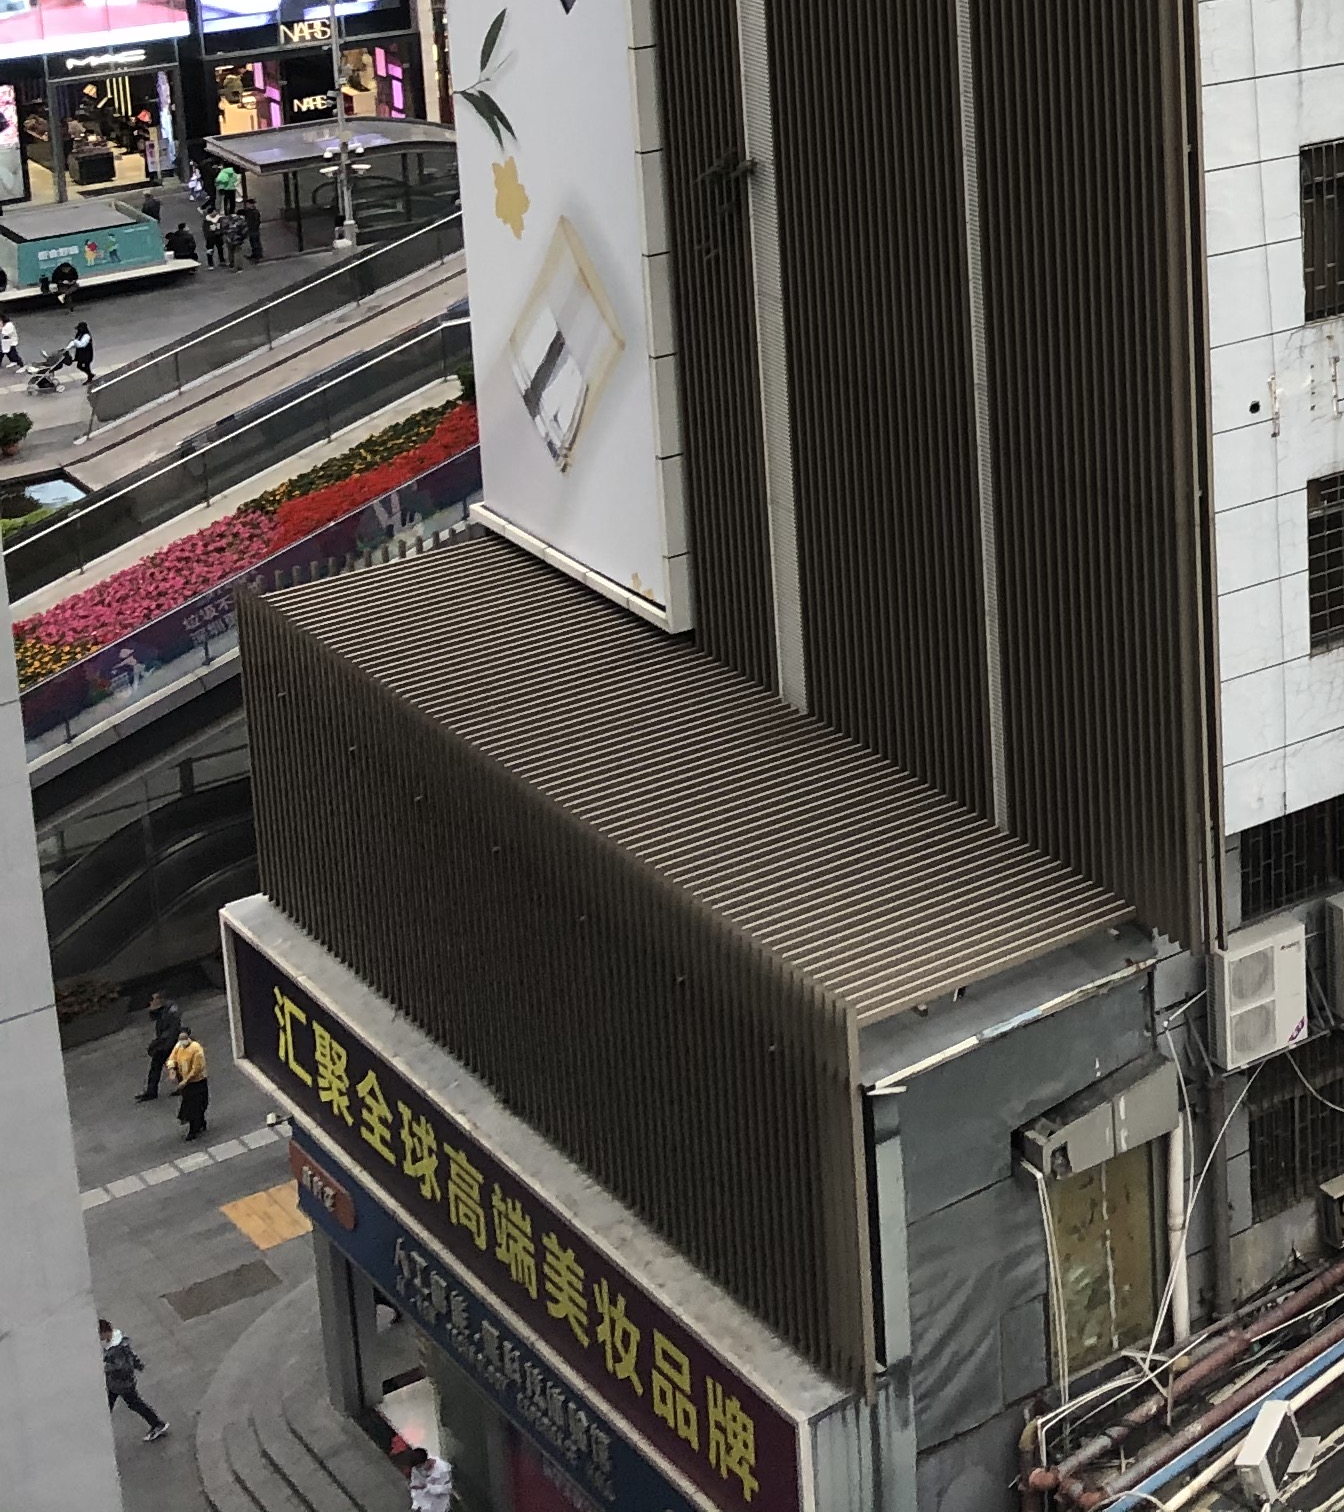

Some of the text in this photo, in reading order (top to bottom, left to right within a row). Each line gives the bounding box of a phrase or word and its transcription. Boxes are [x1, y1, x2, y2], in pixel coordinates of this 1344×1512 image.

[280, 19, 331, 45] NARS
[273, 985, 760, 1503] 汇聚全球高端美妆品牌
